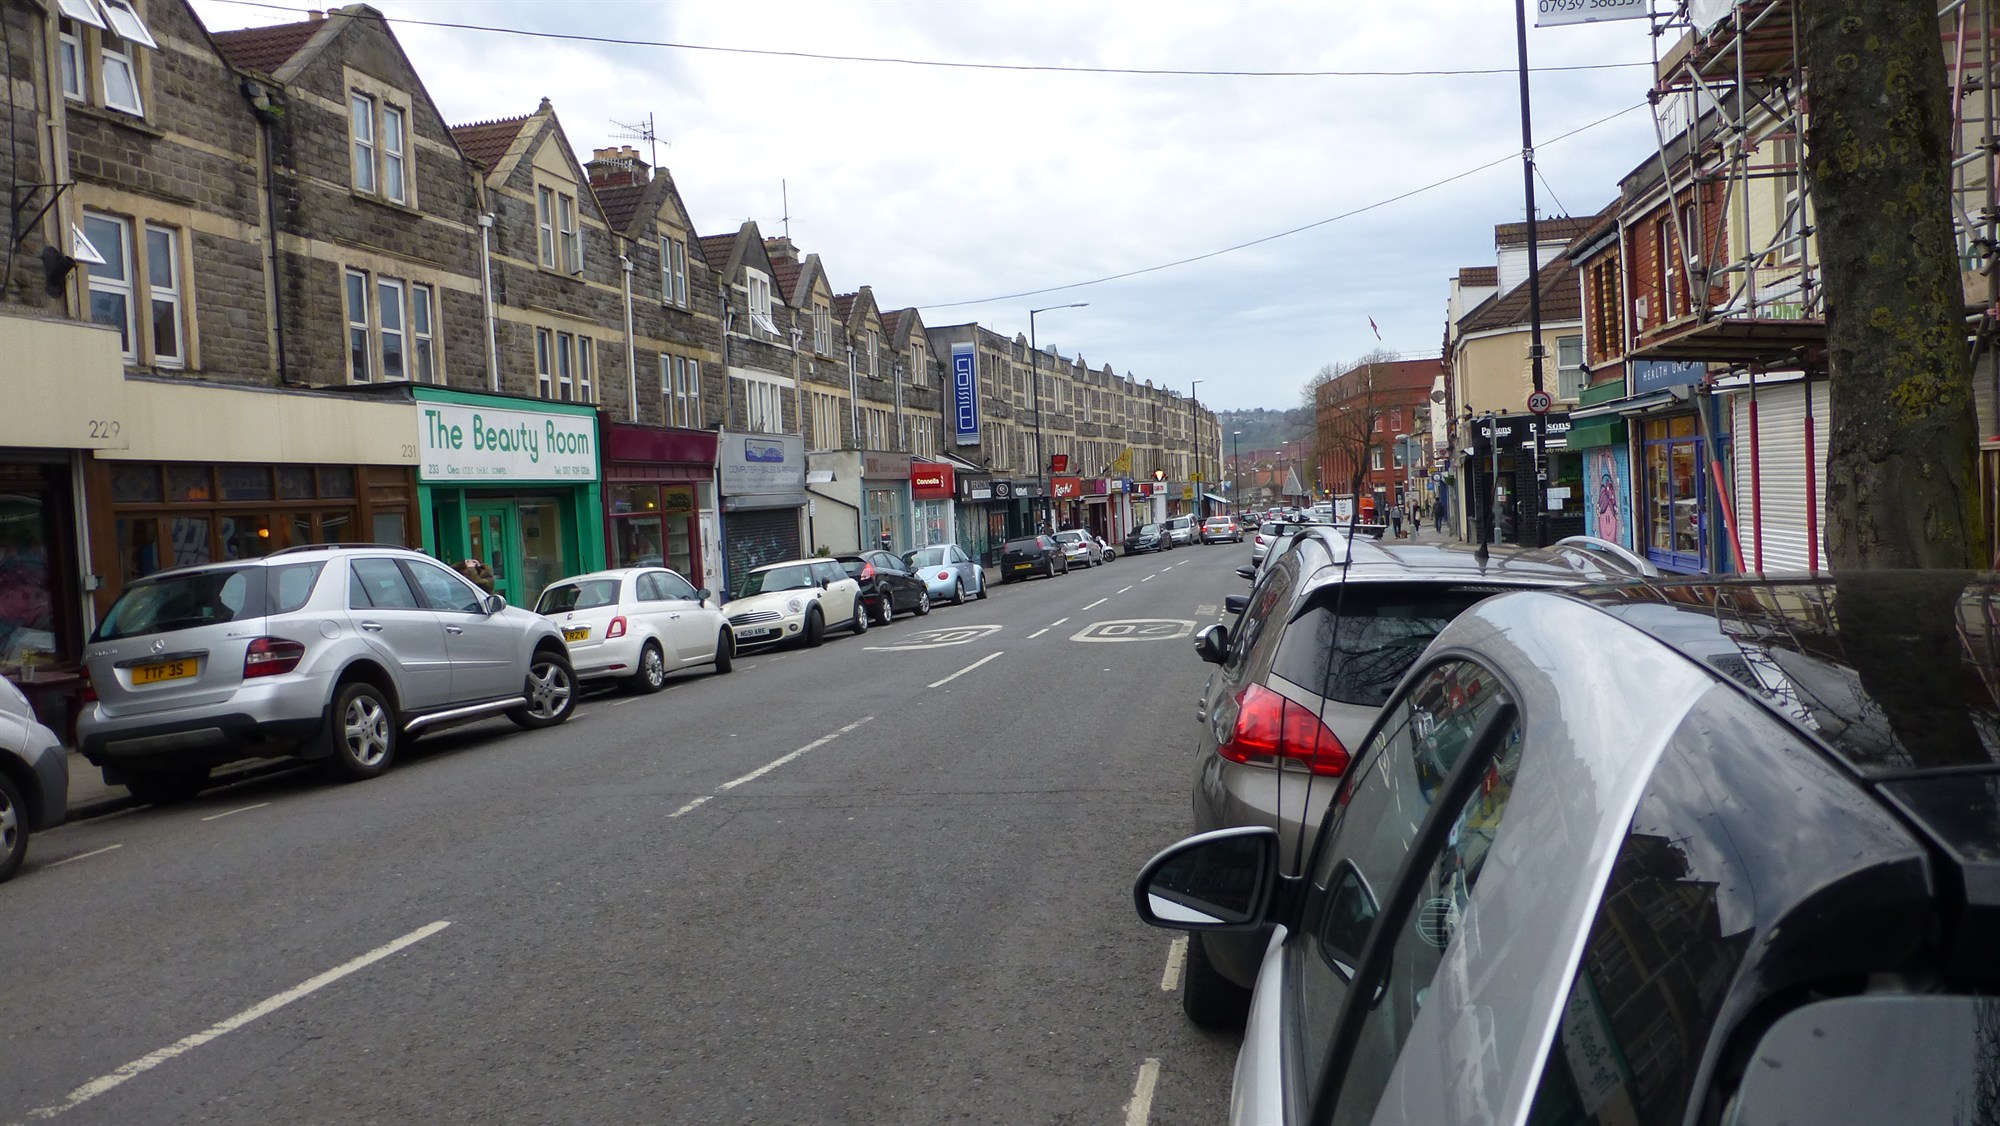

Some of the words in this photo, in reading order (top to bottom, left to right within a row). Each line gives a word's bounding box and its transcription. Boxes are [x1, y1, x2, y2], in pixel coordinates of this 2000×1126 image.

[1642, 365, 1669, 382] HEALTH
[1531, 398, 1548, 407] 20
[89, 420, 121, 439] 229
[1481, 427, 1511, 436] Pasons
[1529, 422, 1571, 432] Psons
[424, 409, 463, 450] The
[473, 413, 538, 463] Beauty
[546, 419, 589, 455] Room
[402, 444, 416, 459] 231
[428, 464, 440, 474] 233
[916, 478, 940, 486] Connells
[569, 630, 585, 640] RZV
[144, 665, 166, 680] TTF
